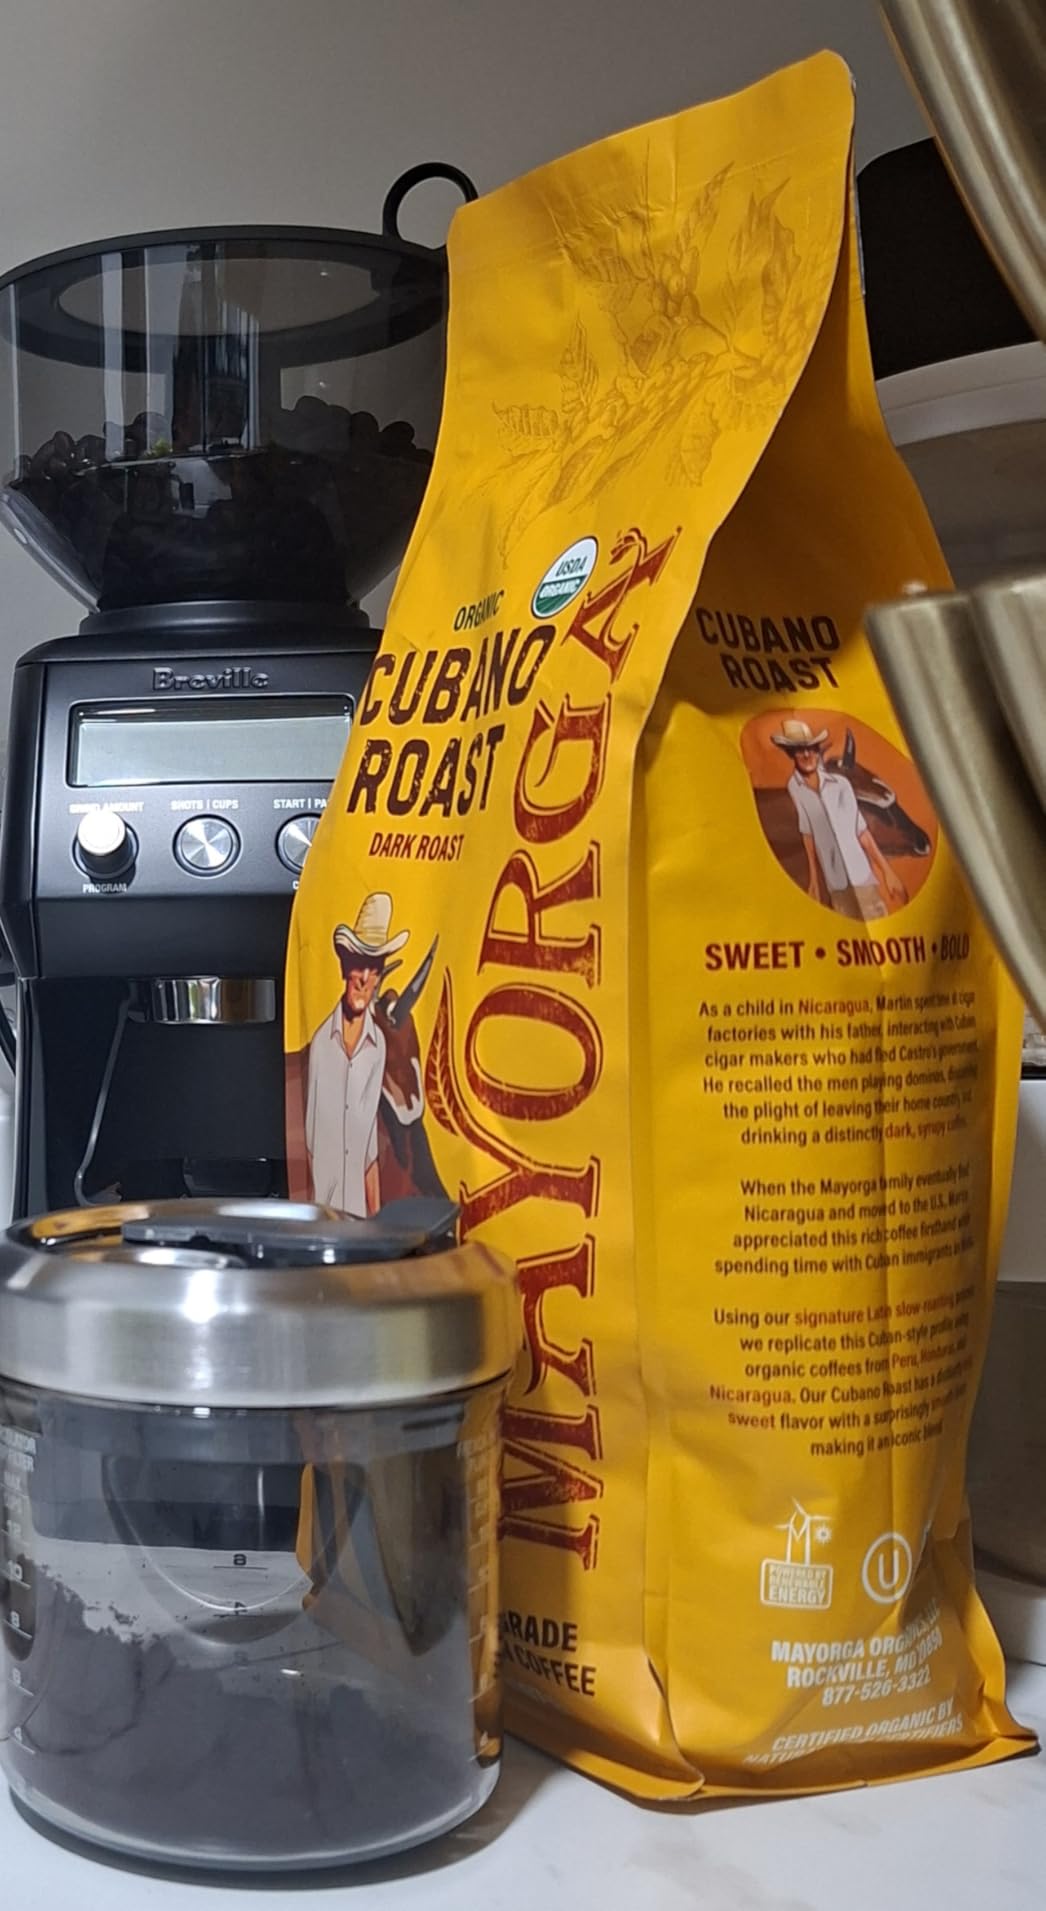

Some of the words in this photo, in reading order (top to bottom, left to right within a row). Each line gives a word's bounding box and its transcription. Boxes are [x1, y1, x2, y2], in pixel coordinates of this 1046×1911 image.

[555, 556, 588, 577] USDA
[539, 578, 581, 598] ORGANIC
[454, 590, 504, 631] ORGANIC
[695, 606, 840, 654] CUBANO
[152, 667, 270, 691] Breville
[359, 625, 556, 726] CUBANO
[720, 653, 839, 692] ROAST
[346, 725, 505, 817] ROAST
[171, 800, 203, 810] SHOTS
[212, 799, 239, 809] CUPS
[273, 799, 305, 809] START
[369, 832, 414, 858] DARK
[415, 834, 464, 861] ROAST
[83, 883, 127, 894] PROGRAM
[705, 941, 804, 971] SWEET
[837, 936, 926, 967] SMOOTH
[941, 933, 970, 961] BOLD
[699, 1002, 718, 1017] As
[723, 1005, 732, 1016] a
[736, 1000, 774, 1016] child
[780, 999, 794, 1015] in
[799, 999, 873, 1017] Nicaragua,
[876, 995, 913, 1011] Martin
[707, 1024, 776, 1042] factories
[781, 1024, 815, 1040] with
[820, 1023, 843, 1040] his
[428, 525, 682, 1571] MAYORGA
[705, 1051, 744, 1070] cigar
[750, 1050, 808, 1067] makers
[813, 1048, 846, 1065] who
[850, 1047, 872, 1064] had
[703, 1077, 723, 1093] He
[728, 1075, 792, 1092] recalled
[797, 1074, 822, 1091] the
[827, 1076, 857, 1091] men
[862, 1071, 902, 1092] playing
[724, 1103, 748, 1119] the
[753, 1101, 799, 1121] plight
[804, 1101, 818, 1117] of
[823, 1100, 872, 1121] leaving
[874, 1097, 899, 1114] their
[903, 1095, 930, 1112] home
[741, 1127, 807, 1146] drinking
[812, 1130, 821, 1143] a
[825, 1123, 882, 1145] distinctly
[885, 1121, 916, 1139] dark,
[740, 1179, 786, 1196] When
[791, 1179, 815, 1195] the
[820, 1177, 877, 1199] Mayorga
[879, 1173, 913, 1193] family
[744, 1205, 825, 1225] Nicaragua
[829, 1204, 855, 1221] and
[859, 1202, 896, 1218] moved
[900, 1200, 910, 1215] to
[913, 1197, 928, 1213] the
[733, 1230, 827, 1250] appreciated
[832, 1229, 857, 1246] this
[861, 1227, 884, 1244] rich
[884, 1224, 918, 1242] coffee
[715, 1257, 789, 1277] spending
[794, 1256, 827, 1272] time
[832, 1254, 862, 1272] with
[865, 1250, 899, 1270] Cuban
[903, 1244, 952, 1265] immigrants
[714, 1309, 759, 1328] Using
[764, 1313, 790, 1326] our
[795, 1308, 864, 1328] signature
[867, 1305, 893, 1321] Latin
[740, 1337, 763, 1350] we
[768, 1335, 837, 1354] replicate
[841, 1332, 865, 1348] this
[868, 1325, 928, 1347] Cuban-style
[745, 1363, 805, 1381] organic
[809, 1360, 862, 1377] coffees
[865, 1356, 890, 1373] from
[892, 1350, 920, 1369] Peru,
[709, 1385, 795, 1407] Nicaragua.
[800, 1387, 825, 1403] Our
[831, 1384, 880, 1402] Cubano
[883, 1379, 912, 1396] Roast
[914, 1375, 929, 1391] has
[728, 1411, 775, 1428] sweet
[780, 1413, 824, 1430] flavor
[829, 1411, 860, 1429] with
[863, 1414, 871, 1427] a
[873, 1400, 930, 1424] surprisingly
[810, 1438, 864, 1457] making
[867, 1436, 875, 1451] it
[877, 1436, 890, 1451] an
[890, 1429, 922, 1448] iconic
[769, 1587, 826, 1605] ENERGY
[771, 1639, 865, 1665] MAYORGA
[513, 1644, 597, 1697] COFFEE
[787, 1660, 890, 1688] ROCKVILLE,
[894, 1651, 917, 1675] MD
[822, 1667, 931, 1707] 877-526-3322
[772, 1725, 864, 1752] CERTIFIED
[865, 1707, 935, 1738] ORGANIC
[938, 1697, 954, 1722] BY
